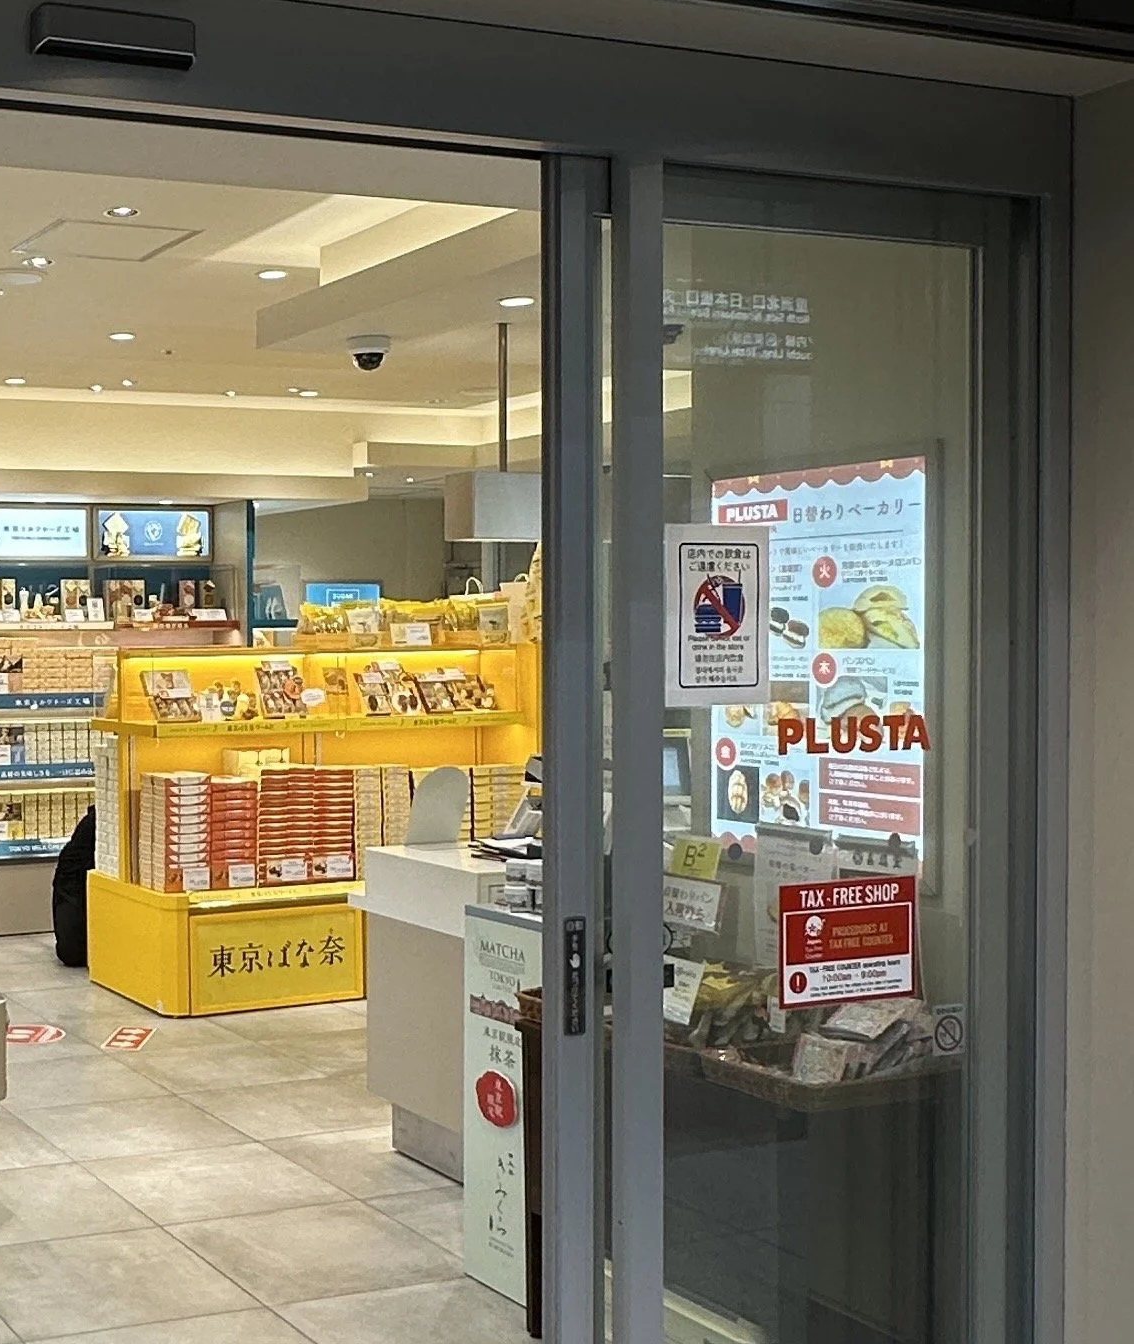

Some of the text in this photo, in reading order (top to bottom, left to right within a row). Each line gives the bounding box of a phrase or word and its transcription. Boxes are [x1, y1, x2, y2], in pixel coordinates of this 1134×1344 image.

[726, 504, 778, 523] PLUSTA
[777, 714, 931, 756] PLUSTA
[865, 882, 900, 904] SHOP
[207, 927, 346, 978] 東京ばな奈
[480, 939, 526, 962] MATCHA
[489, 970, 516, 987] TOKYO
[489, 1044, 516, 1069] 抹茶
